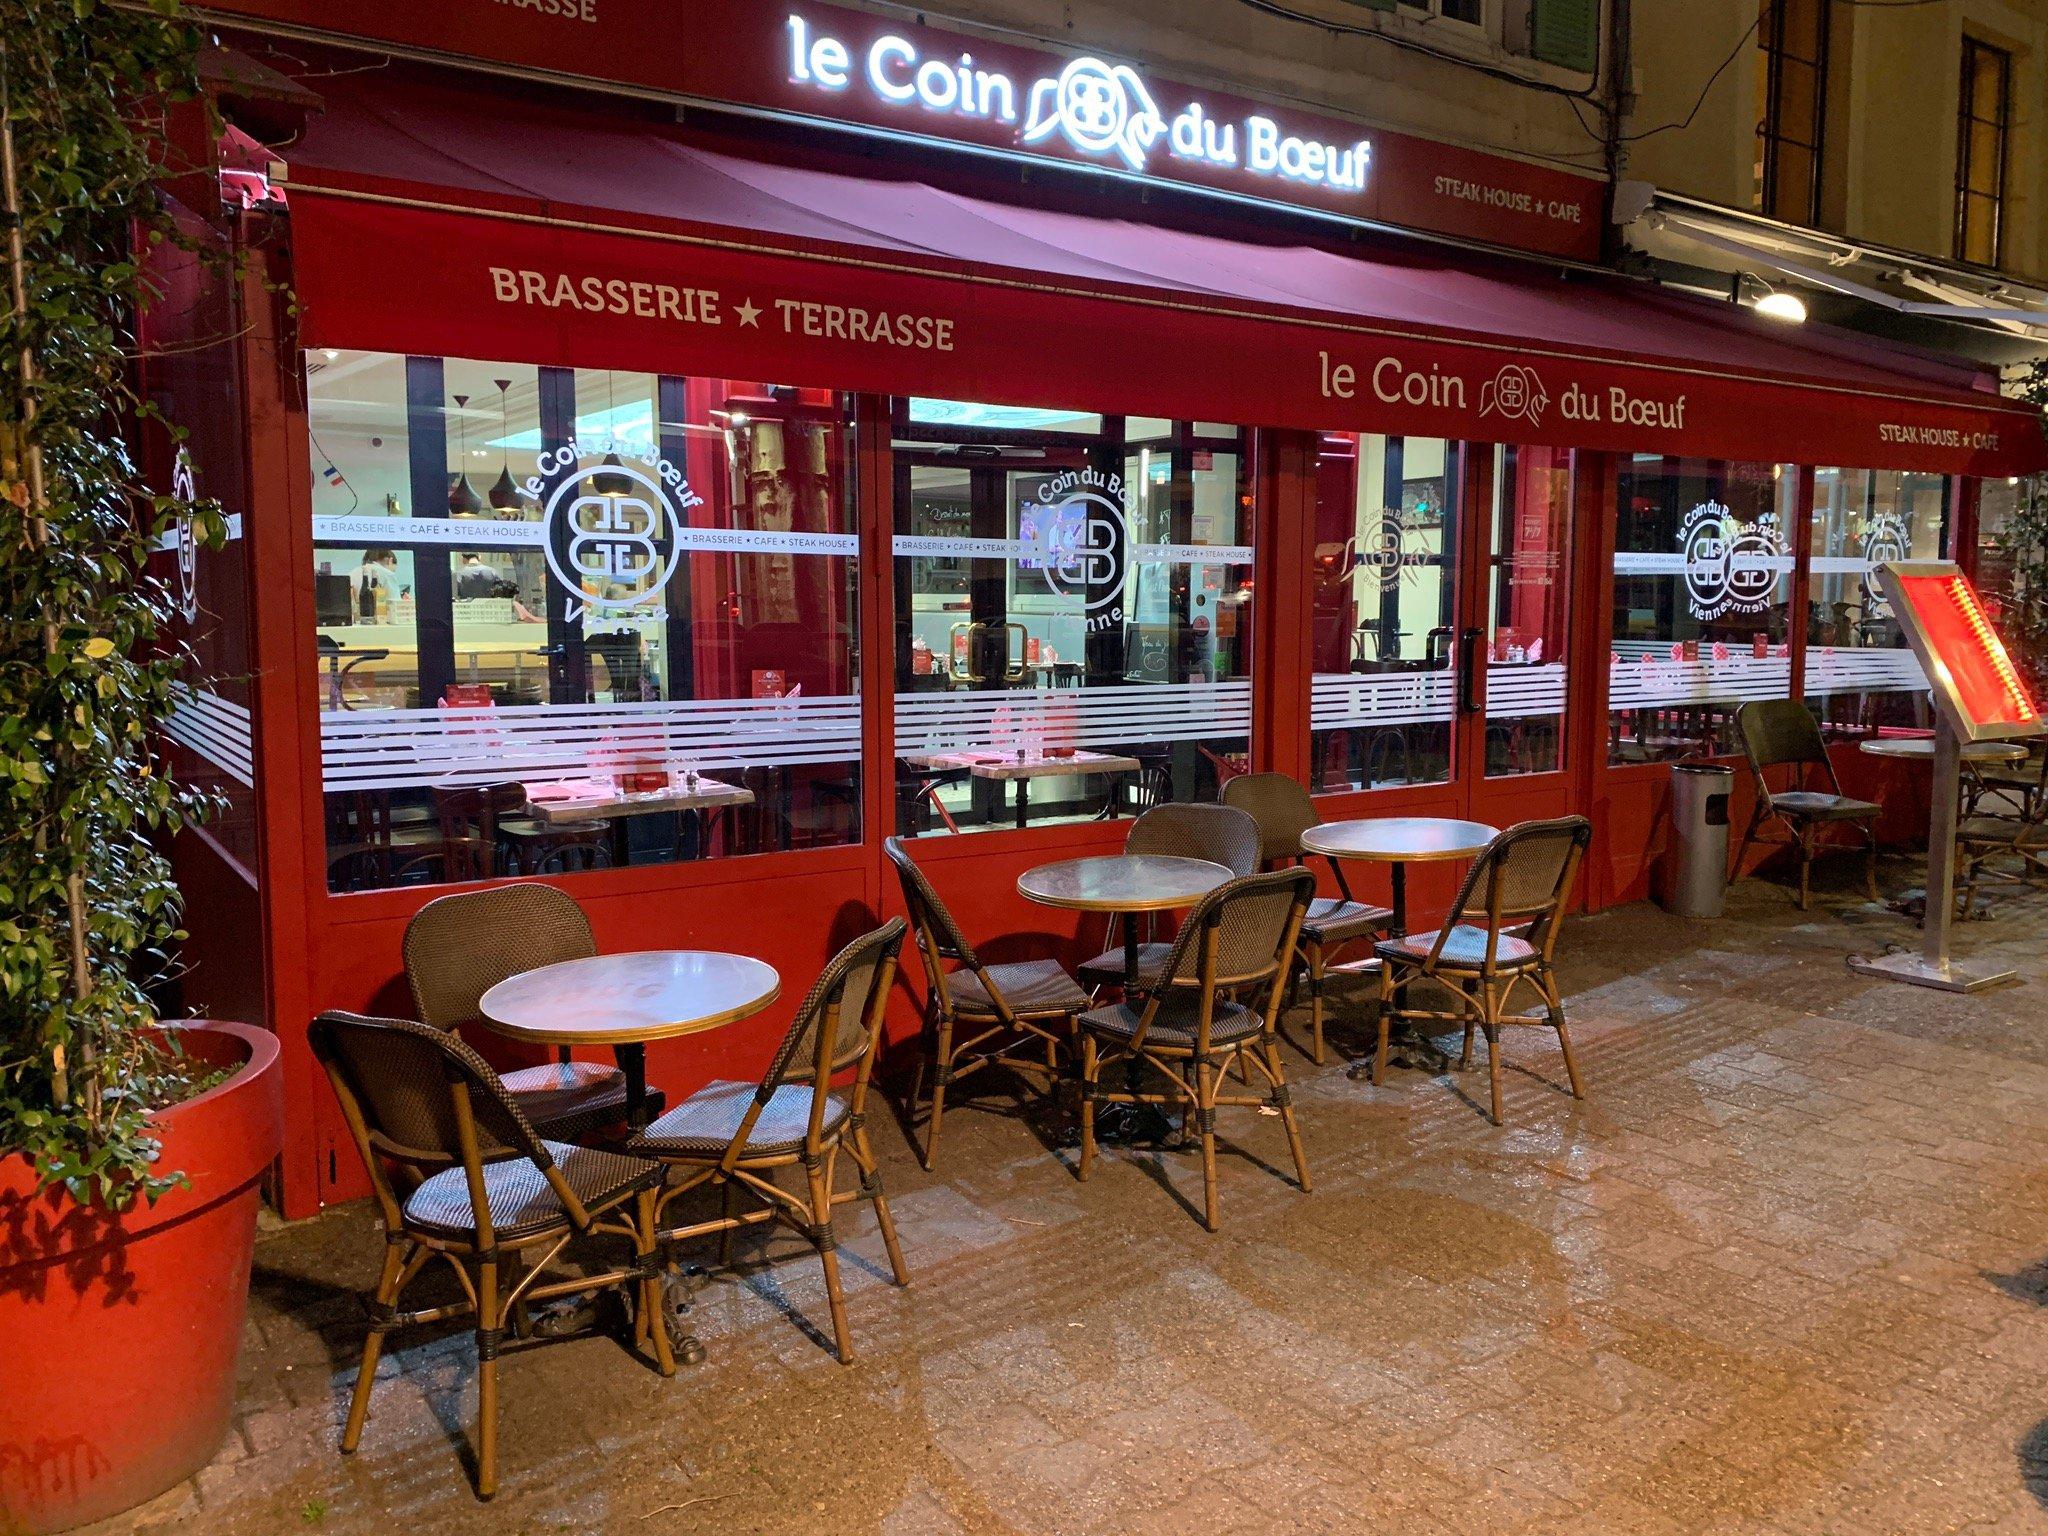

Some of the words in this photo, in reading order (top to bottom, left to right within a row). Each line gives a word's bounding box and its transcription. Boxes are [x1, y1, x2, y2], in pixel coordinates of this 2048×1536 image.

[788, 15, 848, 86] le
[869, 36, 1015, 120] Coin
[1171, 102, 1236, 162] du
[1248, 115, 1370, 188] Bœuf
[1434, 175, 1481, 201] STEAK
[1482, 186, 1531, 213] HOUSE
[1548, 201, 1581, 223] CAFÉ
[490, 267, 721, 325] BRASSERIE
[775, 298, 954, 351] TERRASSE
[1318, 351, 1355, 399] le
[1372, 357, 1466, 409] Coin
[1561, 382, 1601, 421] du
[1609, 387, 1686, 430] Bœuf
[1879, 423, 1918, 443] STEAK
[1920, 427, 1960, 448] HOUSE
[515, 475, 545, 501] le
[641, 442, 705, 508] Bœuf
[1038, 470, 1080, 503] Coin
[1081, 465, 1105, 488] du
[330, 522, 395, 534] BRASSERIE
[454, 525, 490, 536] STEAK
[492, 526, 530, 537] HOUSE
[1684, 502, 1708, 528] Coin
[1707, 499, 1721, 515] du
[692, 534, 743, 545] BRASSERIE
[788, 538, 817, 548] STEAK
[818, 539, 847, 549] HOUSE
[902, 541, 944, 550] BRASSERIE
[982, 543, 1006, 552] STEAK
[1688, 597, 1728, 621] Vienne
